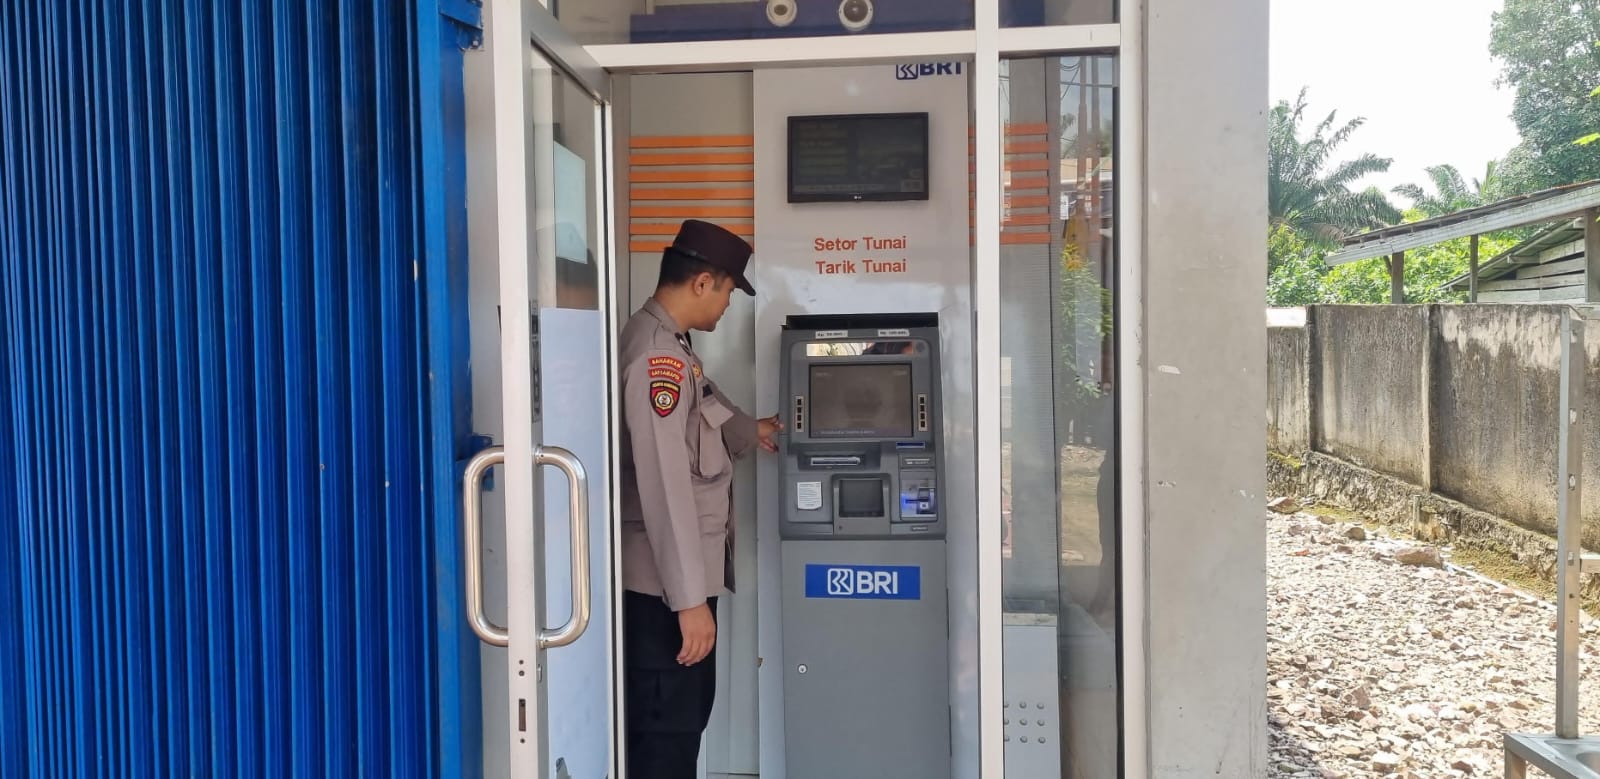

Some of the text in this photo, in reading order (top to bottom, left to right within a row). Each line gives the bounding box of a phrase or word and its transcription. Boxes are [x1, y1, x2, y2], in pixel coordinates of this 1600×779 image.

[920, 62, 961, 76] BRI
[814, 235, 906, 251] Setor Tunai
[815, 258, 906, 274] Tarik Tunai
[856, 570, 898, 594] BRI
